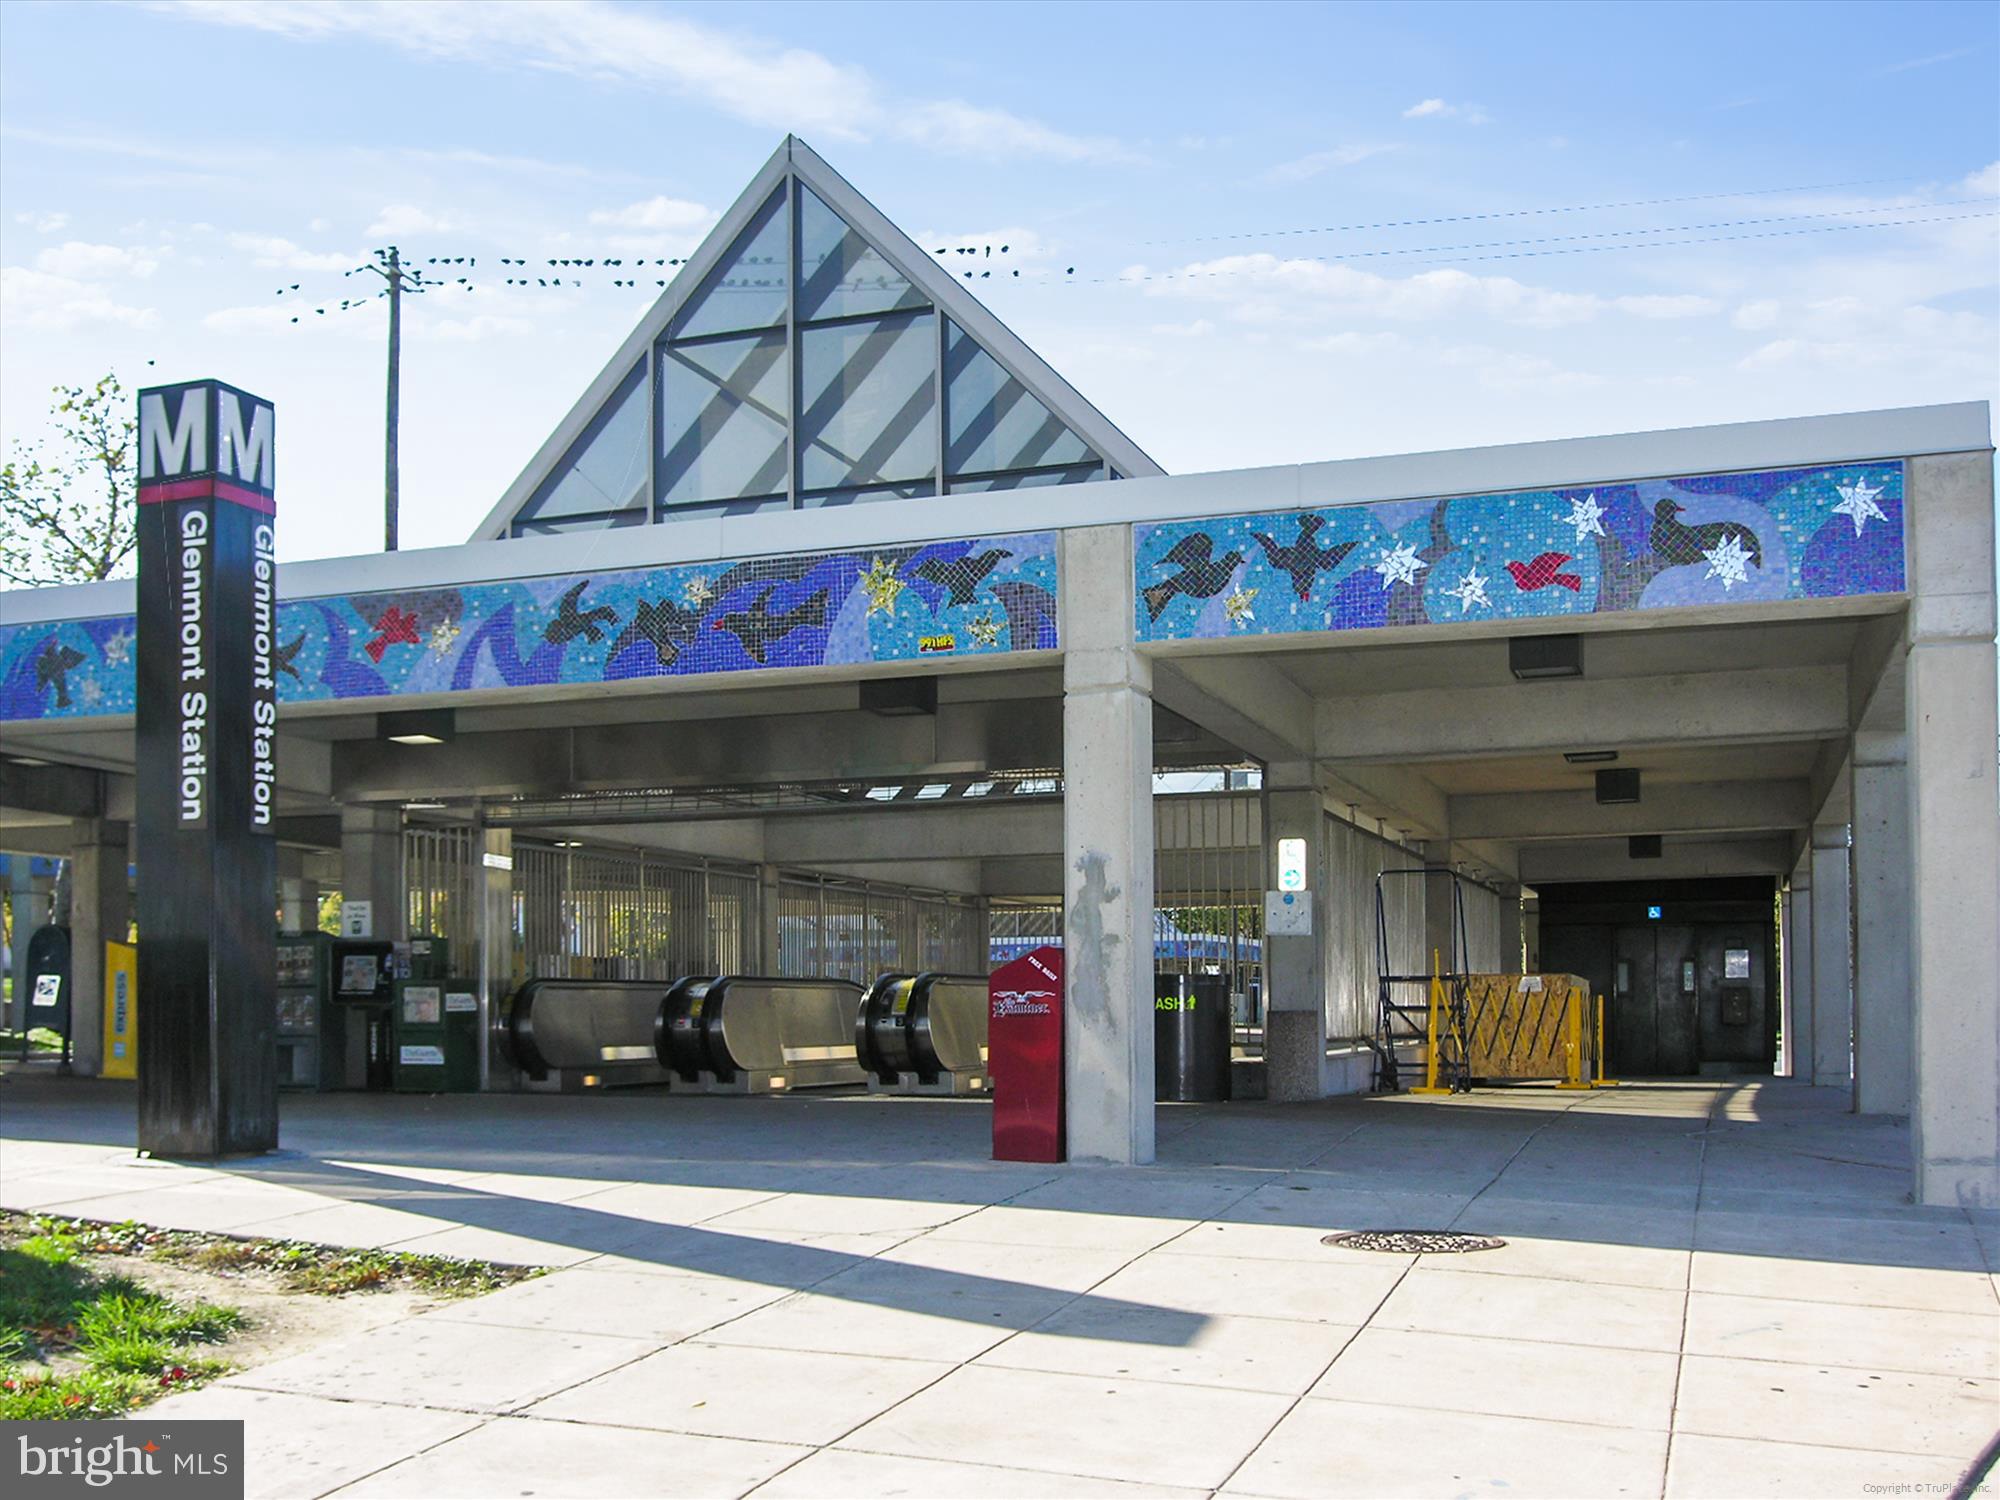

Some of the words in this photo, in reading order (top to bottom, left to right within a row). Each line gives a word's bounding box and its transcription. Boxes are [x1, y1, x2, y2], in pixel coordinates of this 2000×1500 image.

[140, 387, 206, 479] M
[218, 388, 273, 490] M
[182, 510, 208, 681] Glenmont
[254, 524, 275, 690] Glenmont
[181, 692, 208, 820] Station
[254, 699, 276, 825] Station
[1155, 996, 1185, 1011] ASH
